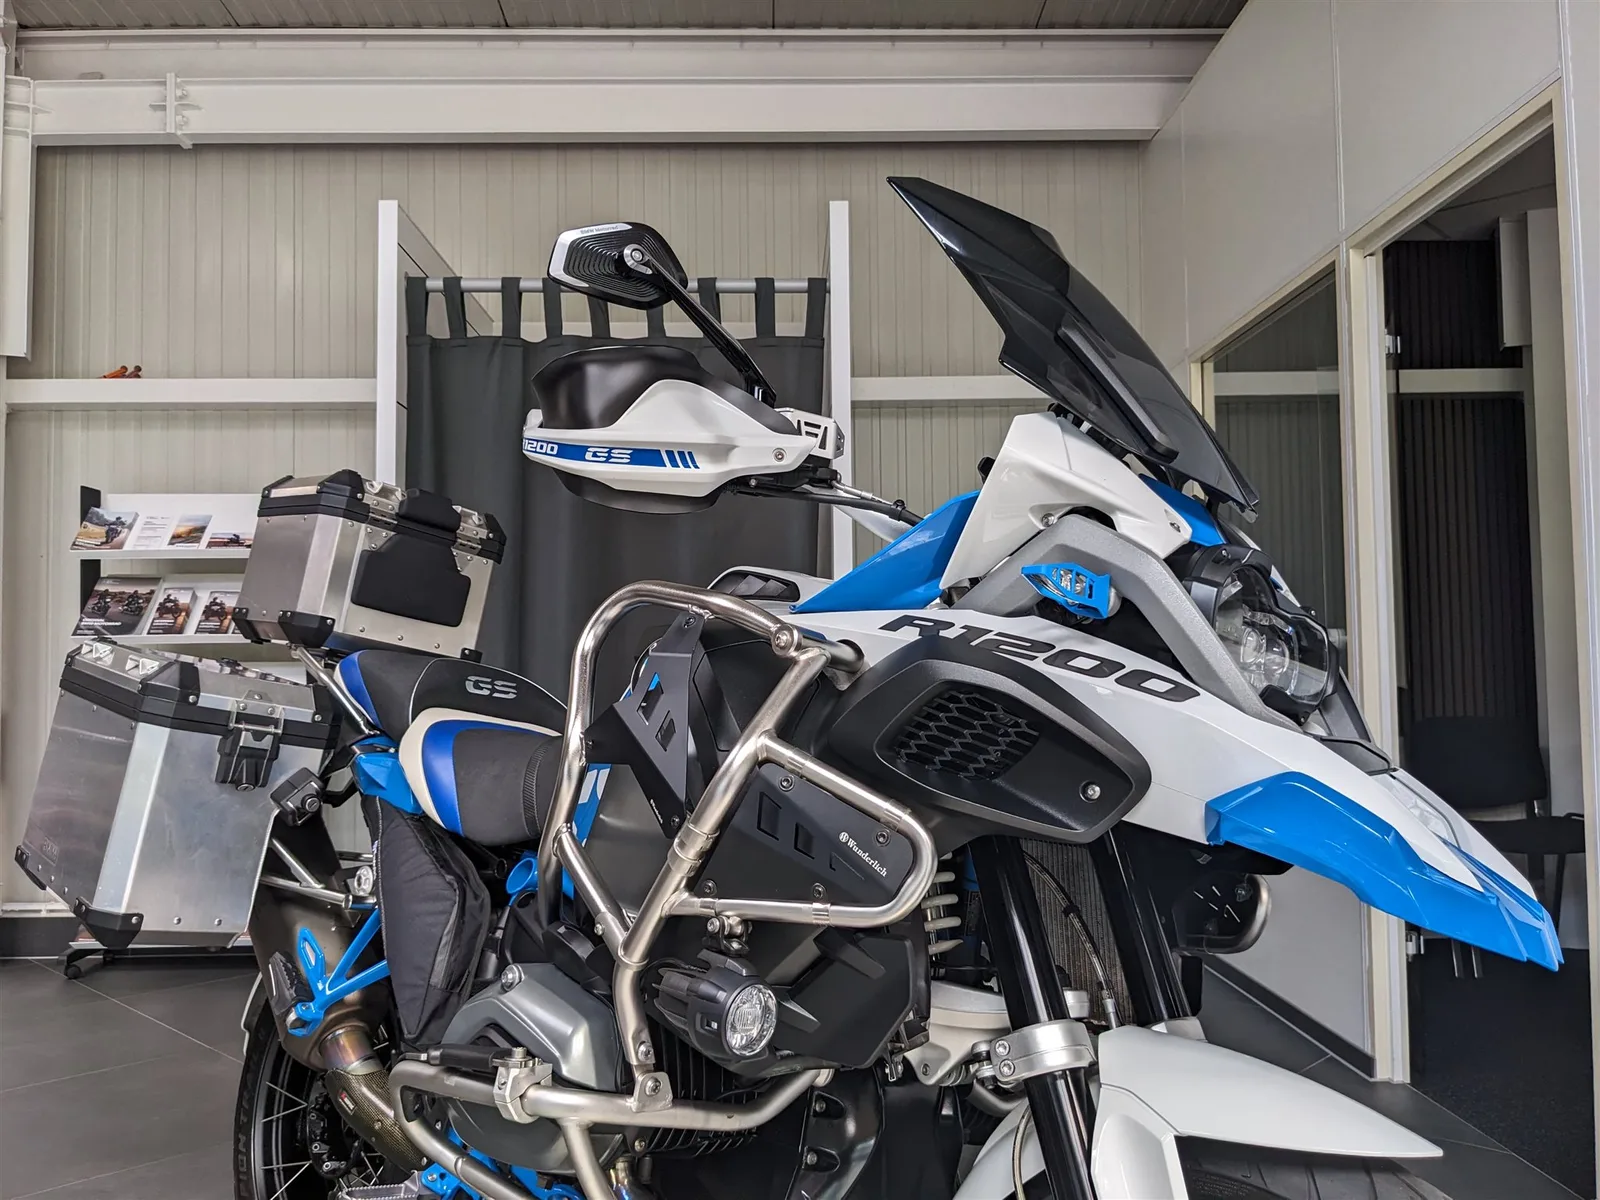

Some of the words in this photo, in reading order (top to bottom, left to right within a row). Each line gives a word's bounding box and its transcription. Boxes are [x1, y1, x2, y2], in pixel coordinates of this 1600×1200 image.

[585, 447, 633, 463] GS
[878, 614, 1201, 702] R1200
[465, 675, 518, 699] GS
[847, 837, 888, 878] Wunderlich
